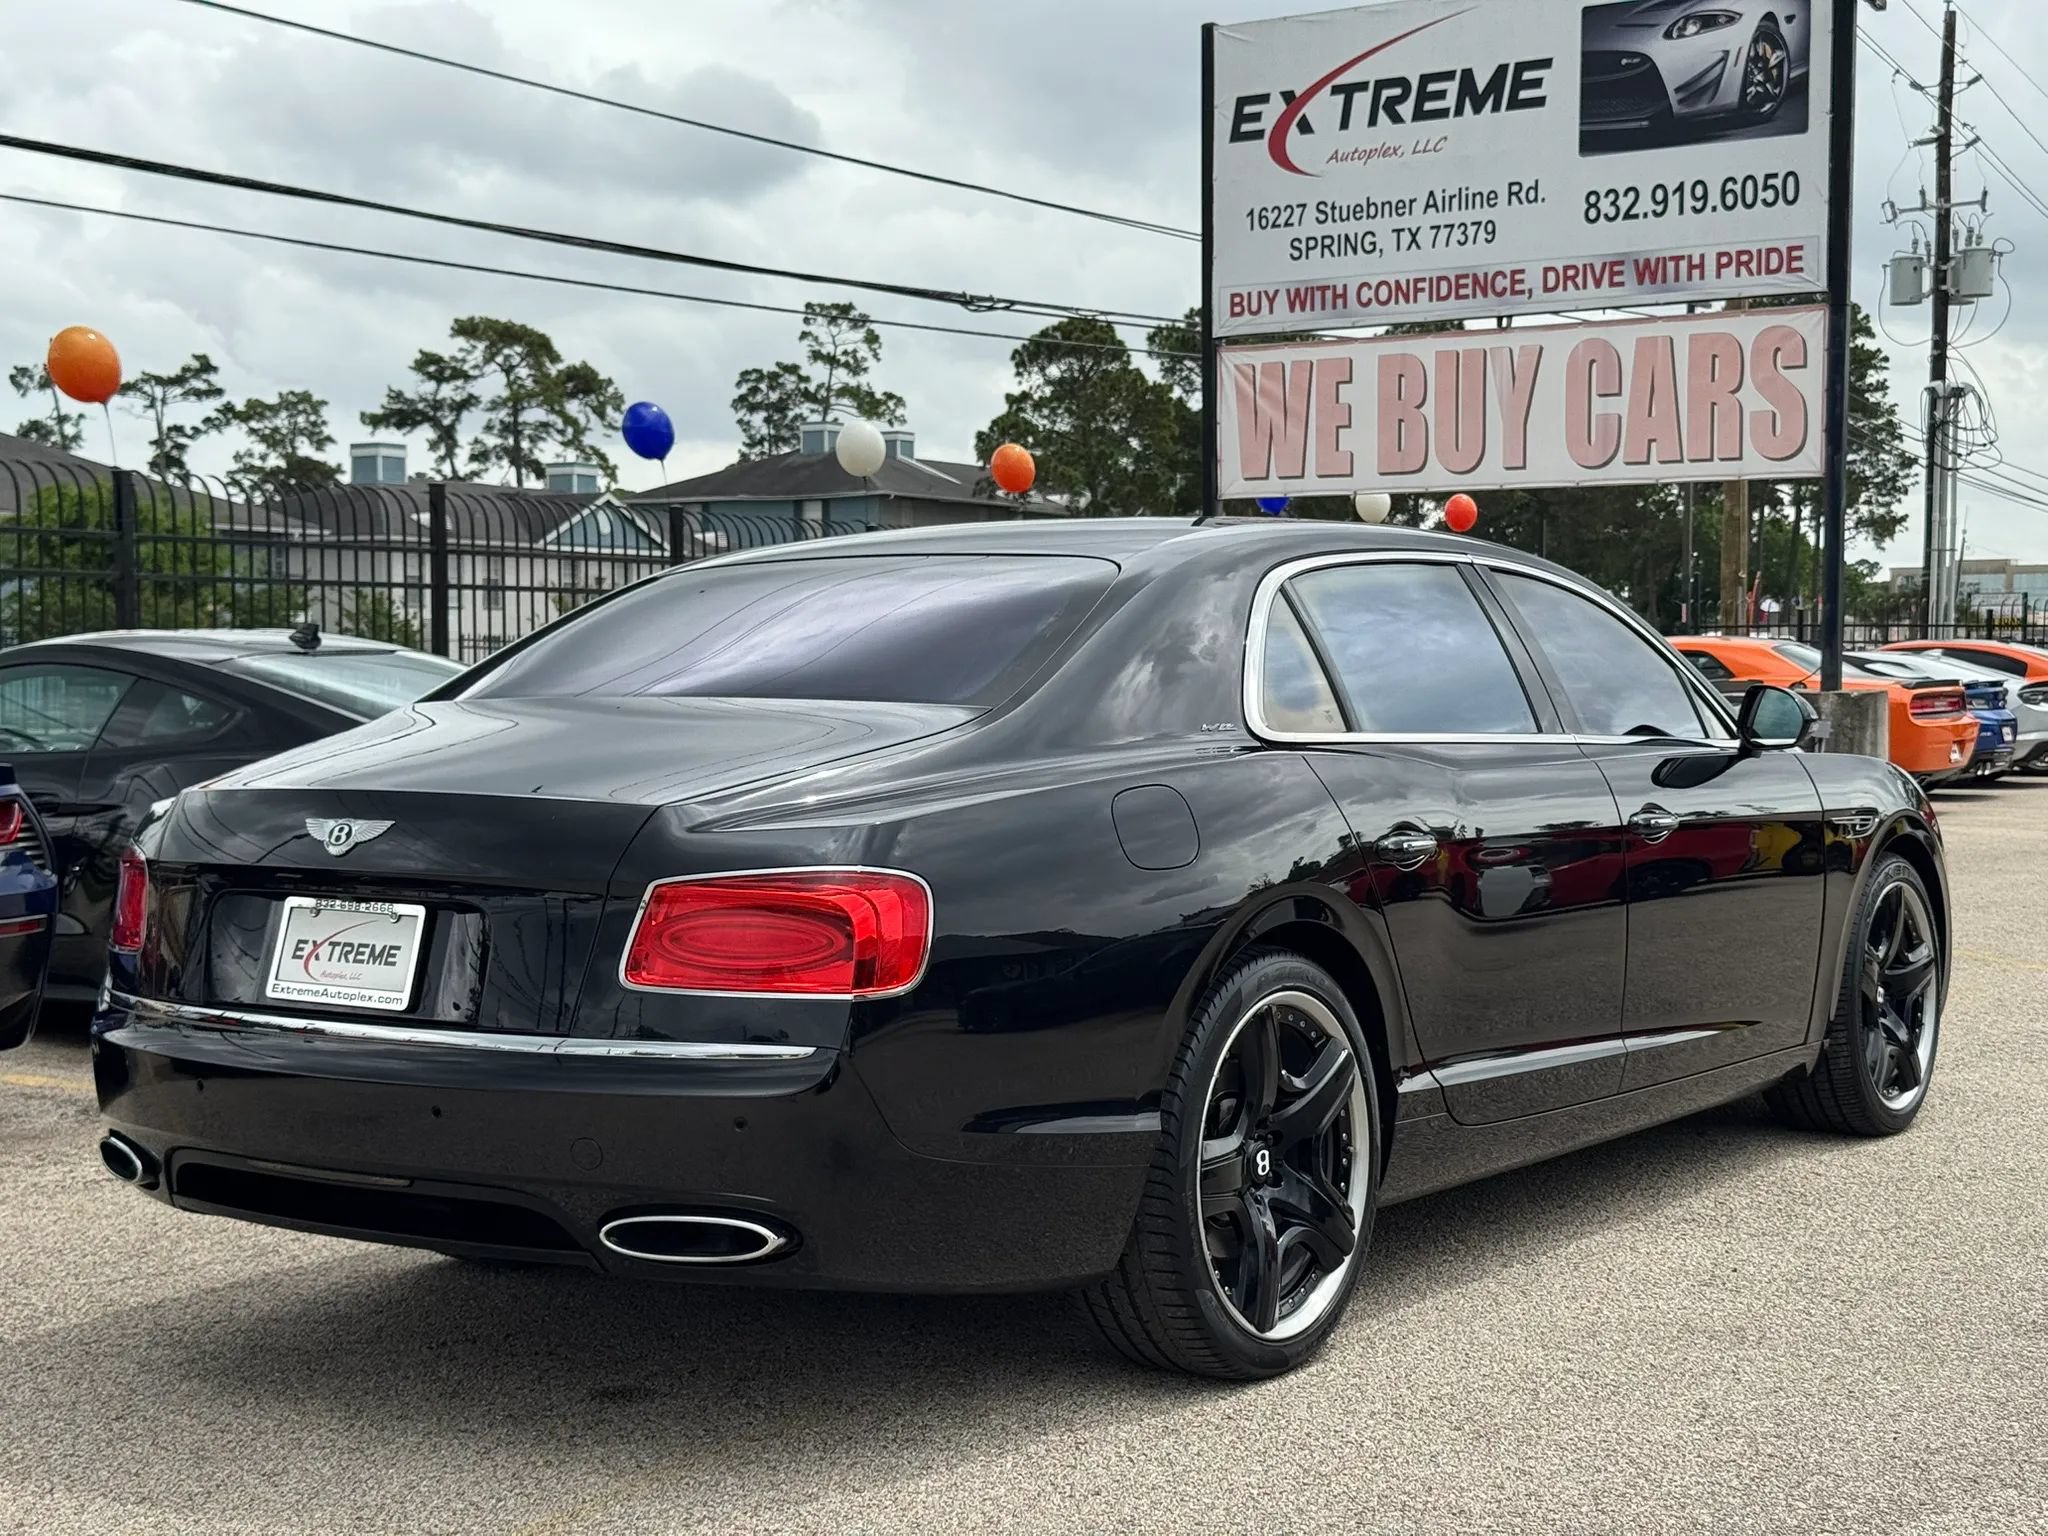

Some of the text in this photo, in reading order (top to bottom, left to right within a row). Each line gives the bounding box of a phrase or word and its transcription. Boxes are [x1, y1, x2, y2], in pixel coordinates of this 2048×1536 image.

[1229, 57, 1554, 144] EXTREME
[1326, 136, 1448, 166] Autoplex, LLC
[1246, 179, 1546, 231] 16227 Stuebner Airline Rd.
[1584, 170, 1801, 224] 832.919.6050
[1289, 219, 1497, 261] SPRING, TX 77379
[1230, 245, 1804, 318] BUY WITH CONFIDENCE, DRIVE WITH PRIDE
[1236, 325, 1808, 479] WE BUY CARS
[291, 939, 402, 967] EXTREME
[271, 983, 404, 1006] ExtremeAutoplex.com
